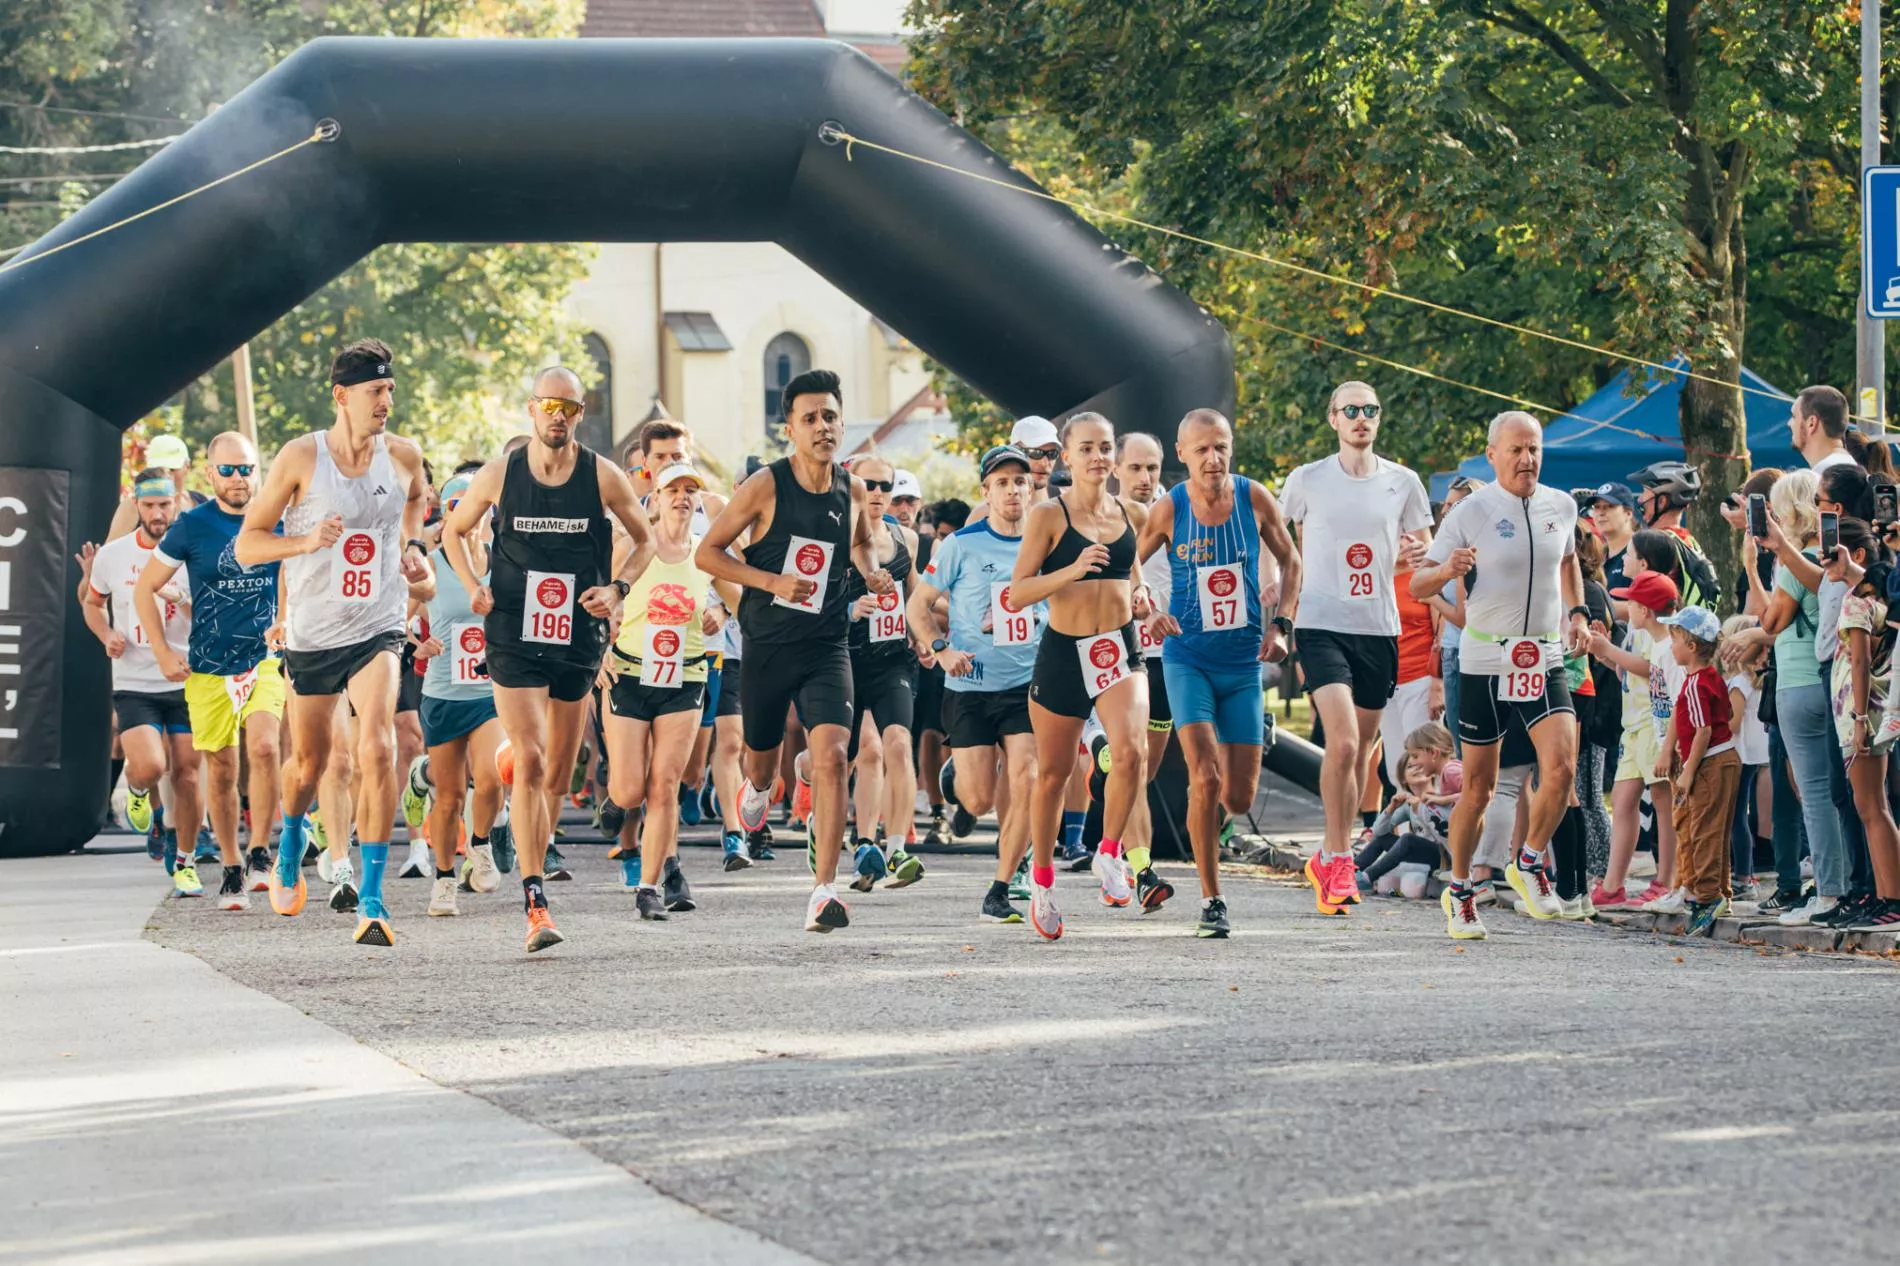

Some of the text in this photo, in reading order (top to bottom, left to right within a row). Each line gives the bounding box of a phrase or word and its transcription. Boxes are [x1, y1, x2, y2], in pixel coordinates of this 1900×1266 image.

[217, 577, 273, 589] PEXTON
[342, 570, 371, 597] 85
[1349, 572, 1373, 596] 29
[1212, 600, 1237, 626] 57
[532, 611, 571, 640] 196
[875, 614, 905, 637] 194
[1006, 617, 1028, 641] 19
[1139, 624, 1164, 647] 8
[457, 657, 490, 680] 16
[653, 660, 677, 684] 77
[1096, 666, 1121, 689] 64
[1507, 672, 1544, 697] 139
